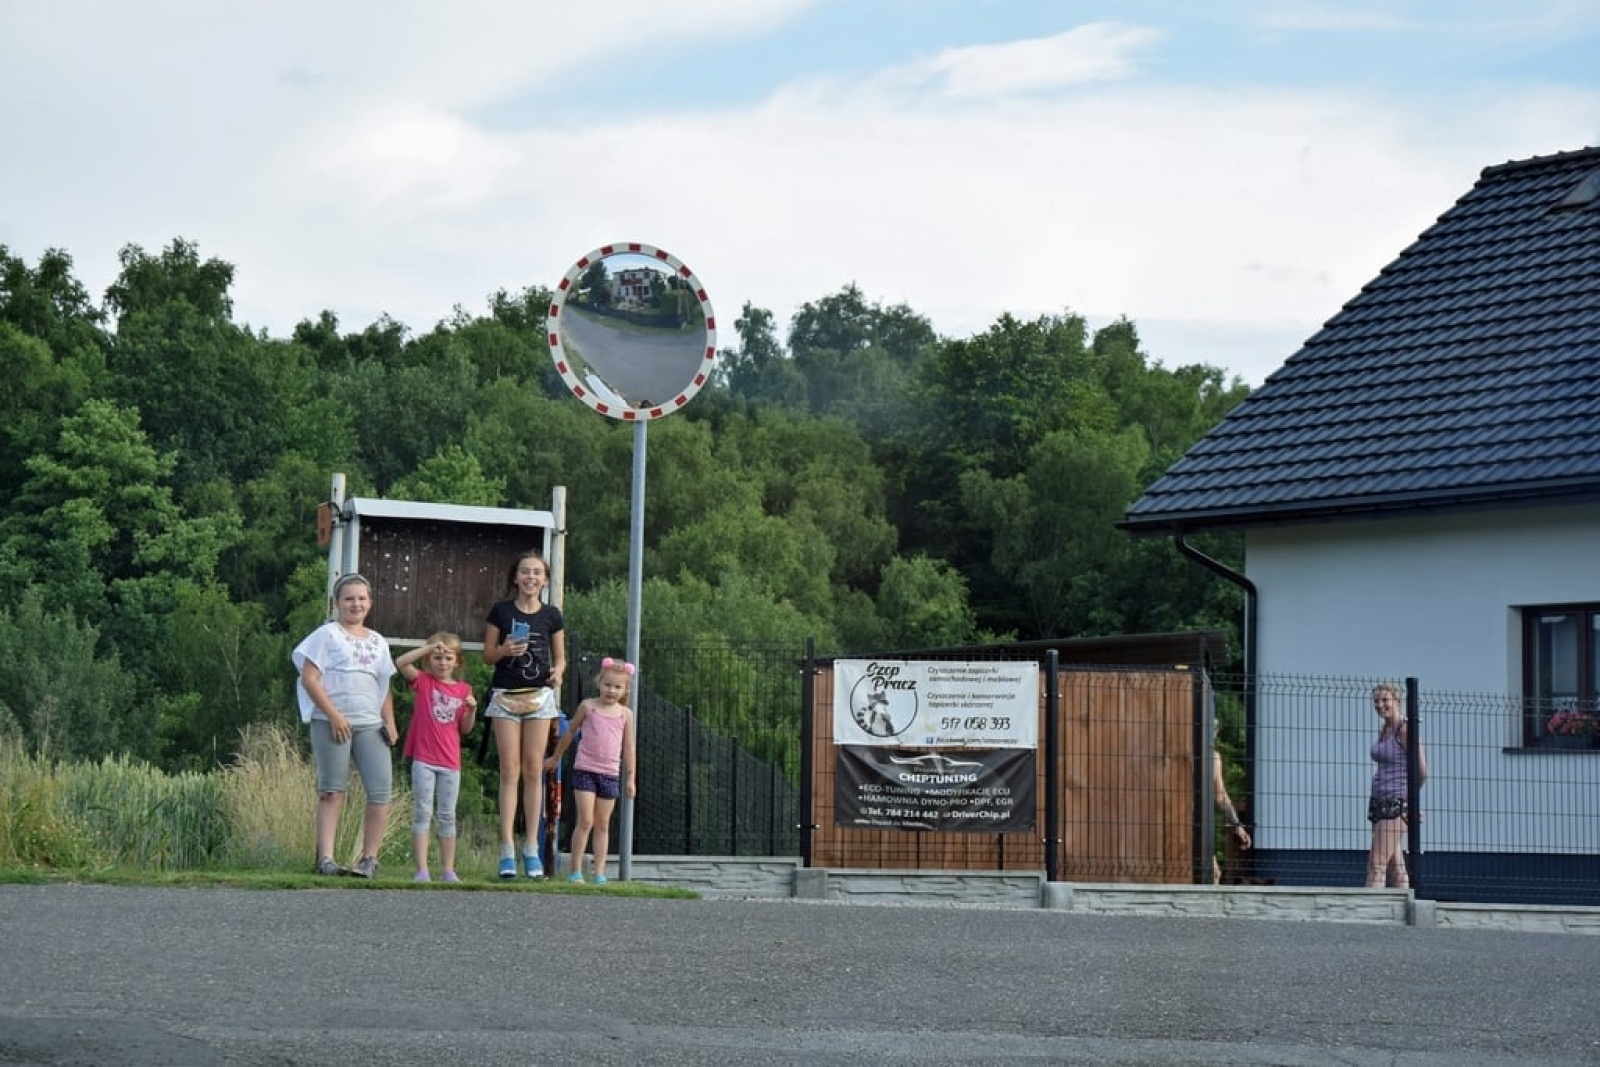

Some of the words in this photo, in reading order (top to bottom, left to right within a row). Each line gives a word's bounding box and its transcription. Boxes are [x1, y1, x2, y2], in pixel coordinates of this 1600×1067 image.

[866, 662, 901, 678] Szop
[871, 677, 917, 691] Pracz
[941, 716, 961, 730] 517
[963, 716, 988, 730] 058
[989, 716, 1011, 730] 393
[899, 772, 978, 784] CHIPTUNING
[992, 787, 1010, 796] ECU
[996, 797, 1013, 806] EGR
